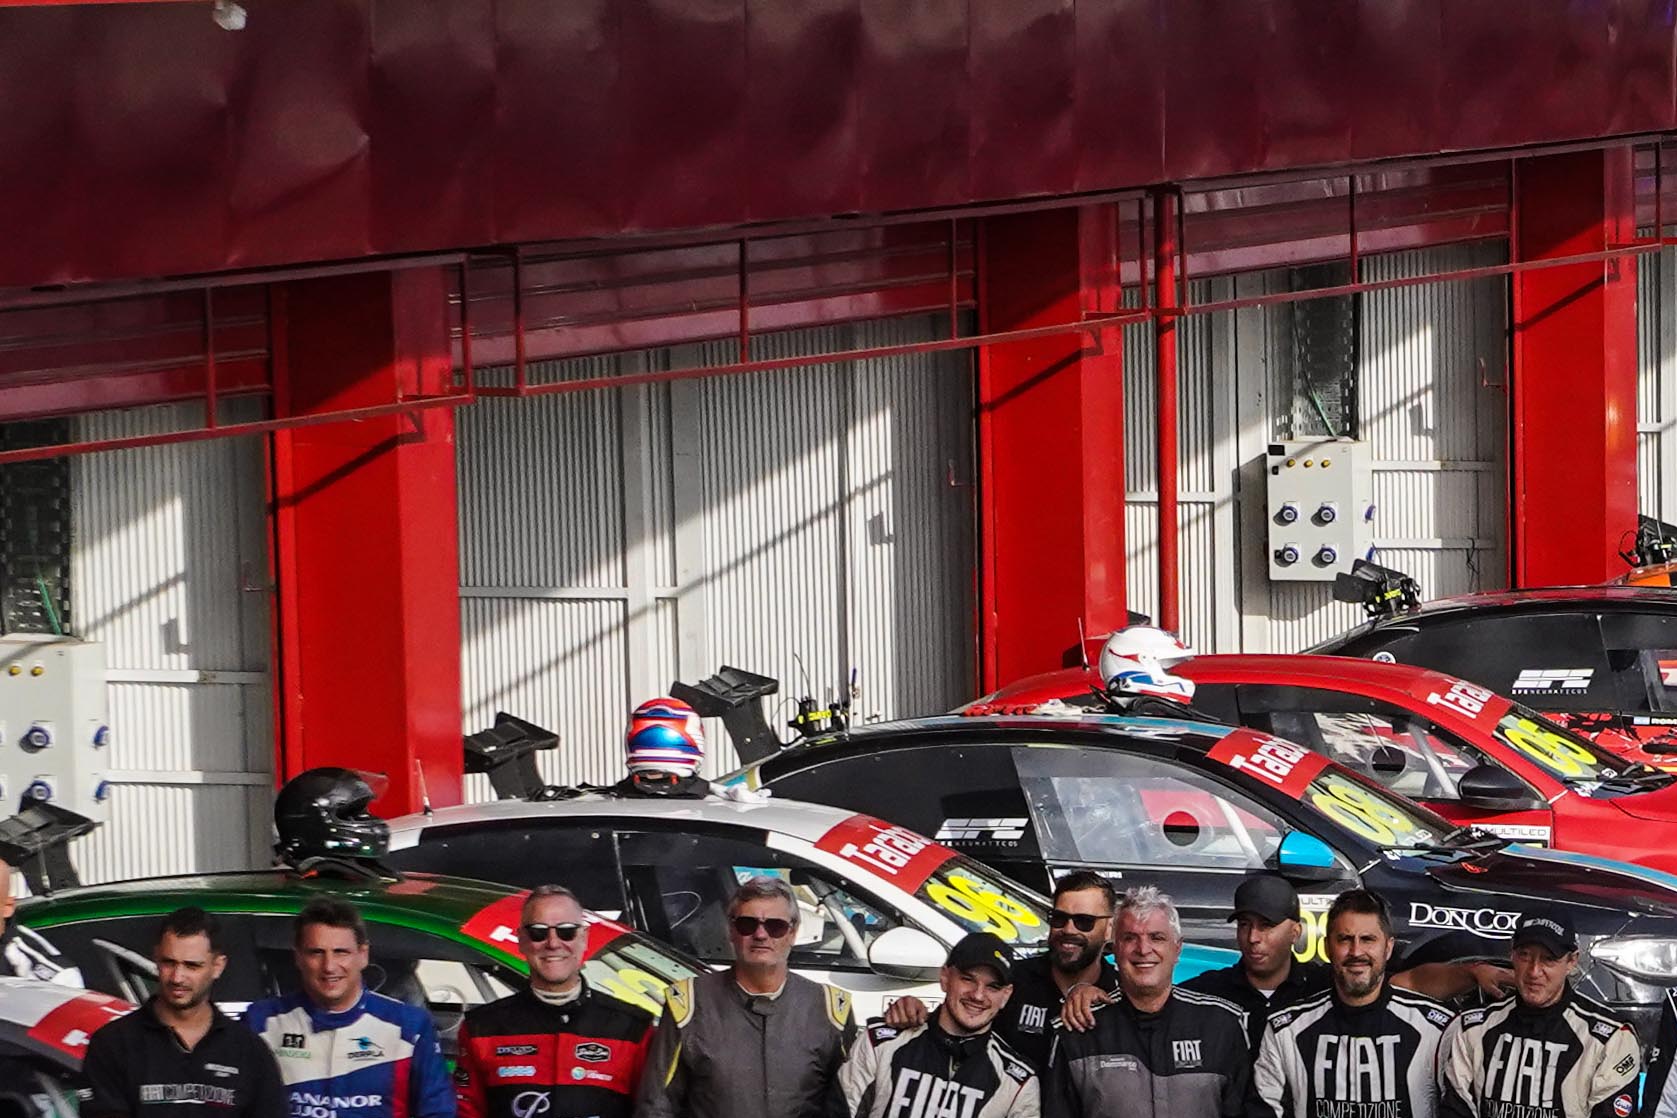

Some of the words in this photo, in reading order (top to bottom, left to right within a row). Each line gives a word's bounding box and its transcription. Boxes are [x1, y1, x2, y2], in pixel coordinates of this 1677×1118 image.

[1408, 901, 1469, 927] DON
[1019, 1003, 1048, 1028] FIAT
[1172, 1039, 1202, 1062] FIAT
[1313, 1034, 1401, 1102] FIAT
[1484, 1032, 1570, 1108] FIAT
[1615, 1056, 1636, 1074] OMP
